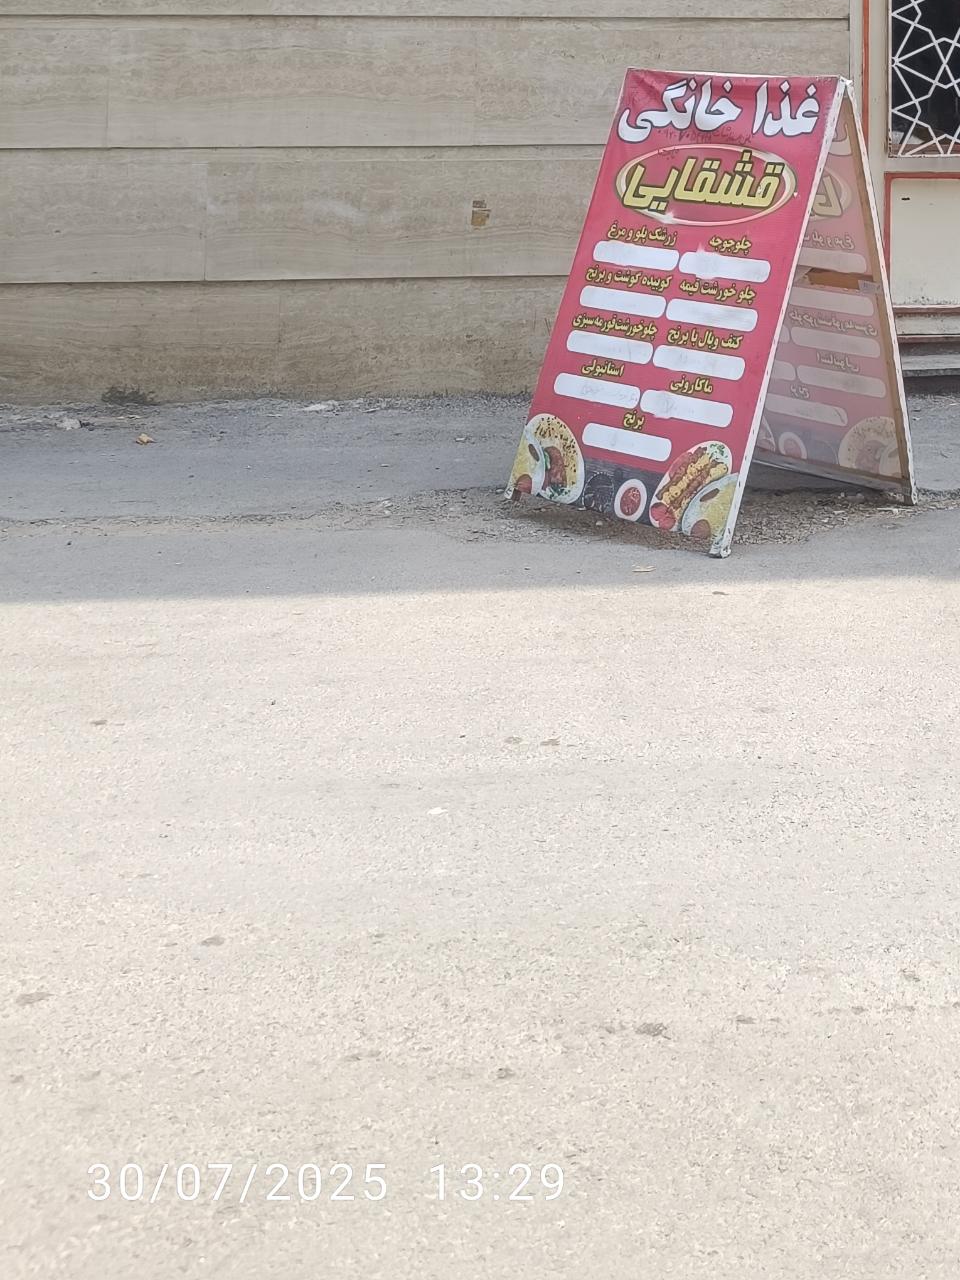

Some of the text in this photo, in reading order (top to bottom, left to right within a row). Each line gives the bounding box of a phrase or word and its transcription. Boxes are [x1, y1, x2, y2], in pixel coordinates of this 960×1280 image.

[617, 77, 742, 143] خانگی
[752, 79, 820, 137] غذا
[622, 149, 785, 215] قشقایی
[607, 220, 626, 239] مرغ
[634, 226, 649, 245] پلو
[648, 226, 678, 247] زرشک
[585, 263, 606, 283] برنج
[641, 273, 672, 293] کوبیده
[679, 278, 757, 306] چلو خورشت قیمه
[667, 325, 690, 344] برنج
[721, 333, 743, 349] کتف
[581, 359, 625, 377] استانبولی
[669, 374, 714, 395] ماکارونی
[622, 409, 645, 429] برنج
